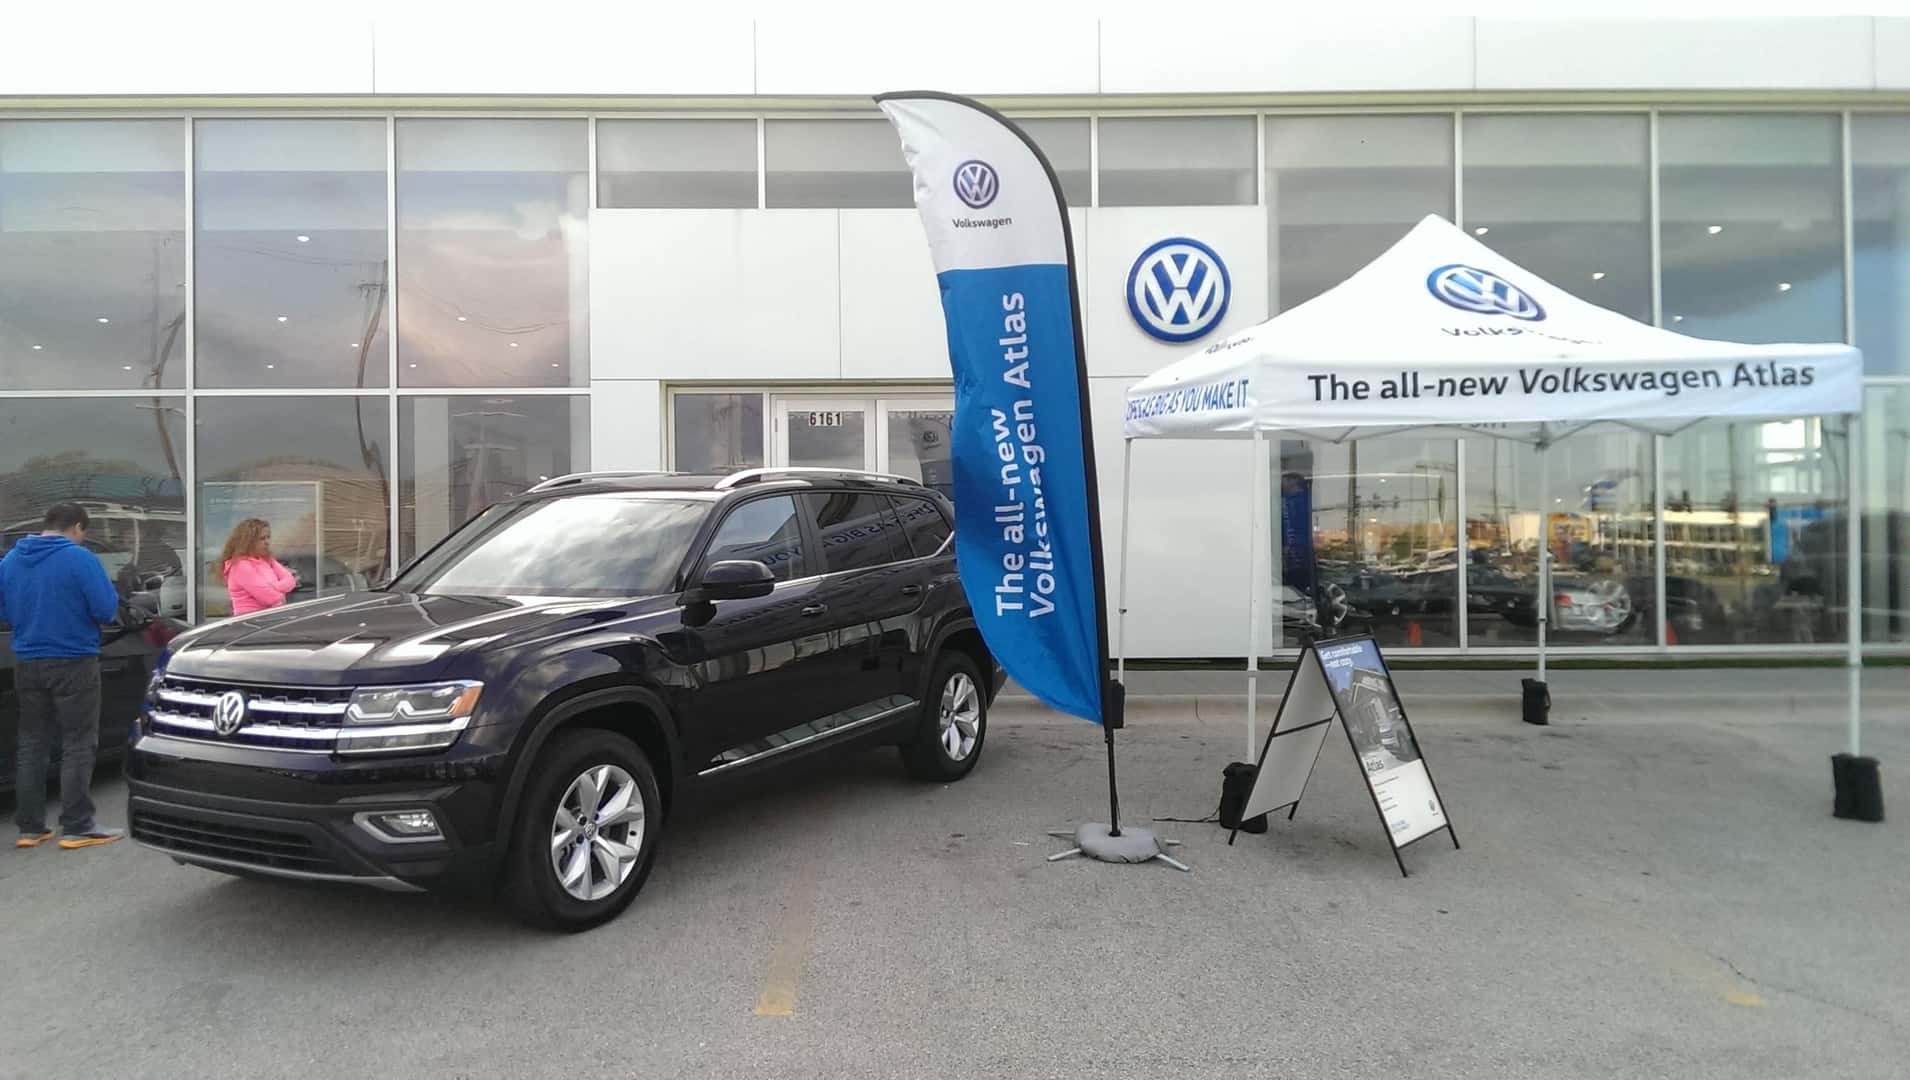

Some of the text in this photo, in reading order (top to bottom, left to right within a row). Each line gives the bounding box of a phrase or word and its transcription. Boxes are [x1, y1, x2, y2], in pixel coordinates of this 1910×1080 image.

[952, 216, 1012, 229] Volkswagen
[1136, 246, 1222, 333] VW
[999, 292, 1031, 389] Atlas
[1181, 387, 1203, 412] YOU
[1201, 381, 1235, 410] MAKE
[1236, 378, 1249, 408] IT
[1308, 360, 1815, 401] The all-new Volkswagen Atlas
[809, 411, 842, 426] 6161
[991, 408, 1025, 616] The all-new
